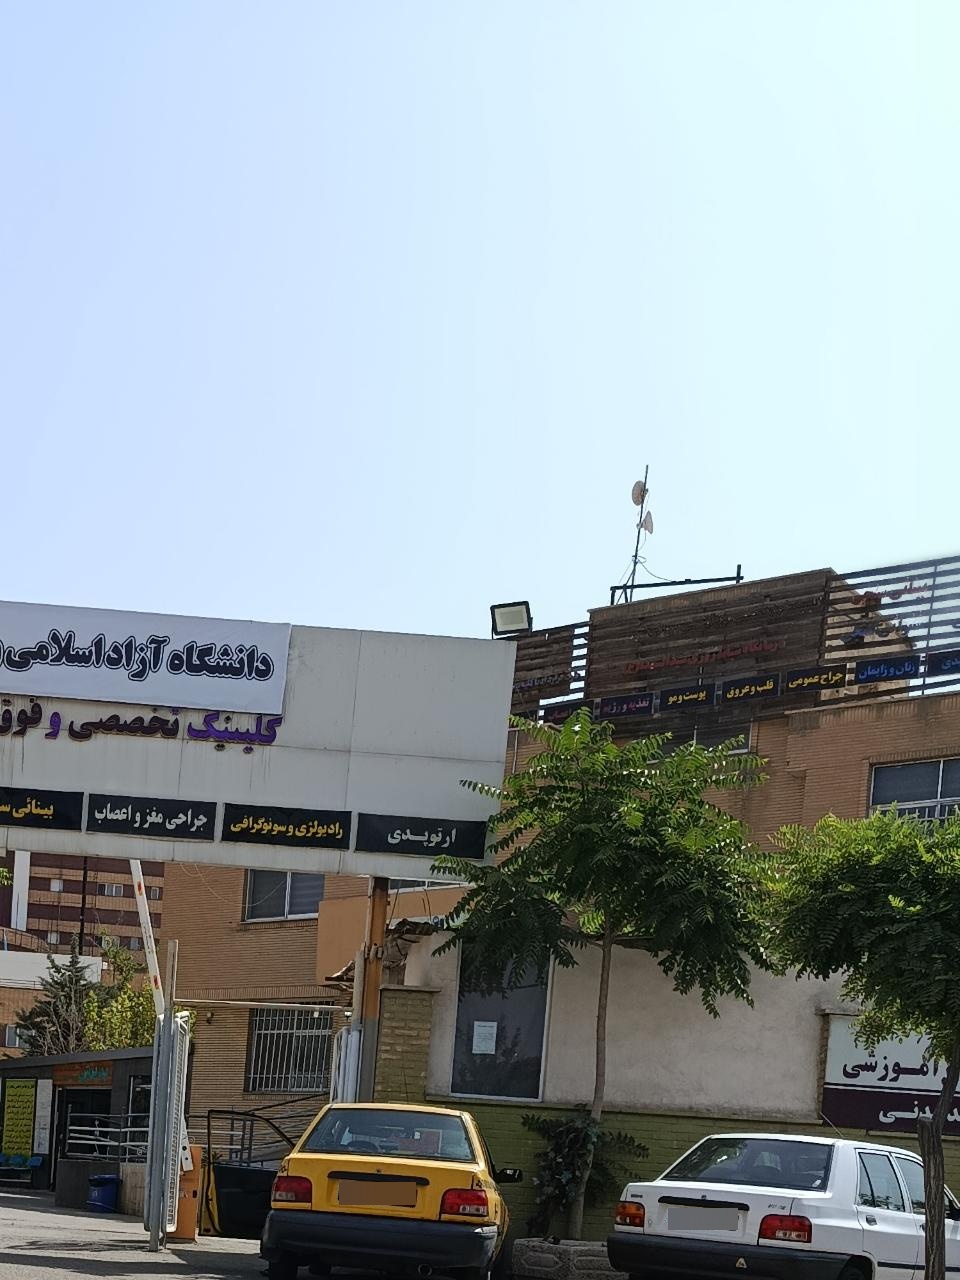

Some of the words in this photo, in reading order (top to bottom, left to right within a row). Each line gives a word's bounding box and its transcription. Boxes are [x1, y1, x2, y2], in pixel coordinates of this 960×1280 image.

[4, 628, 106, 670] اسلامی
[104, 635, 170, 681] آزاد
[167, 639, 274, 681] دانشگاه
[895, 661, 915, 674] زنان
[788, 675, 821, 689] عمومی
[821, 671, 844, 684] جراح
[858, 665, 888, 679] زایمان
[683, 689, 707, 702] پوست
[726, 686, 750, 699] عروق
[757, 678, 775, 693] قلب
[667, 696, 678, 705] مو
[44, 711, 61, 739] و
[68, 707, 180, 741] تخصصی
[187, 711, 283, 754] کلینیک
[94, 802, 132, 824] اعصاب
[133, 811, 141, 828] و
[142, 806, 163, 828] مغز
[165, 808, 208, 831] جراحی
[230, 815, 286, 835] سونوگرافی
[286, 824, 294, 836] و
[387, 824, 457, 847] ارتوپدی
[879, 1101, 934, 1124] دنی
